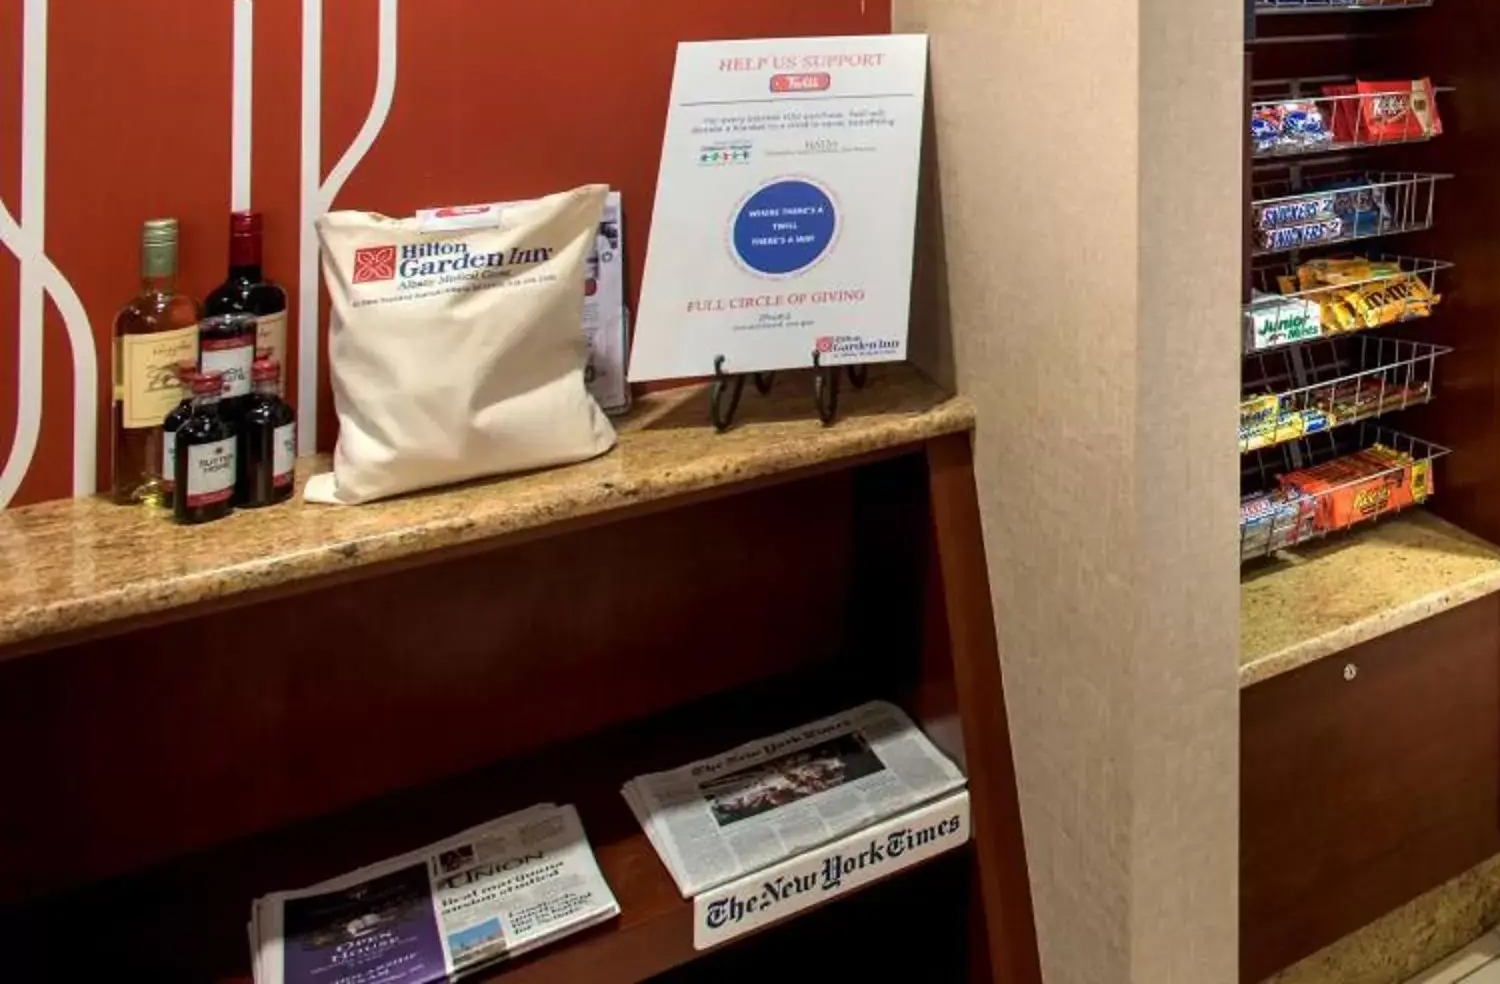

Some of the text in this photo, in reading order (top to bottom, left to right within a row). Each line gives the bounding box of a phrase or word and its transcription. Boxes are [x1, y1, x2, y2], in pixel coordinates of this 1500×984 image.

[718, 52, 886, 73] HELP US SUPPORT
[401, 242, 468, 260] Hilton
[399, 247, 552, 279] Garden Inn
[686, 289, 865, 312] FULL CIRCLE OF GIVING
[1259, 312, 1311, 337] Junior
[1287, 325, 1319, 340] Mints
[833, 339, 876, 353] Garden
[705, 815, 961, 929] The New York Times
